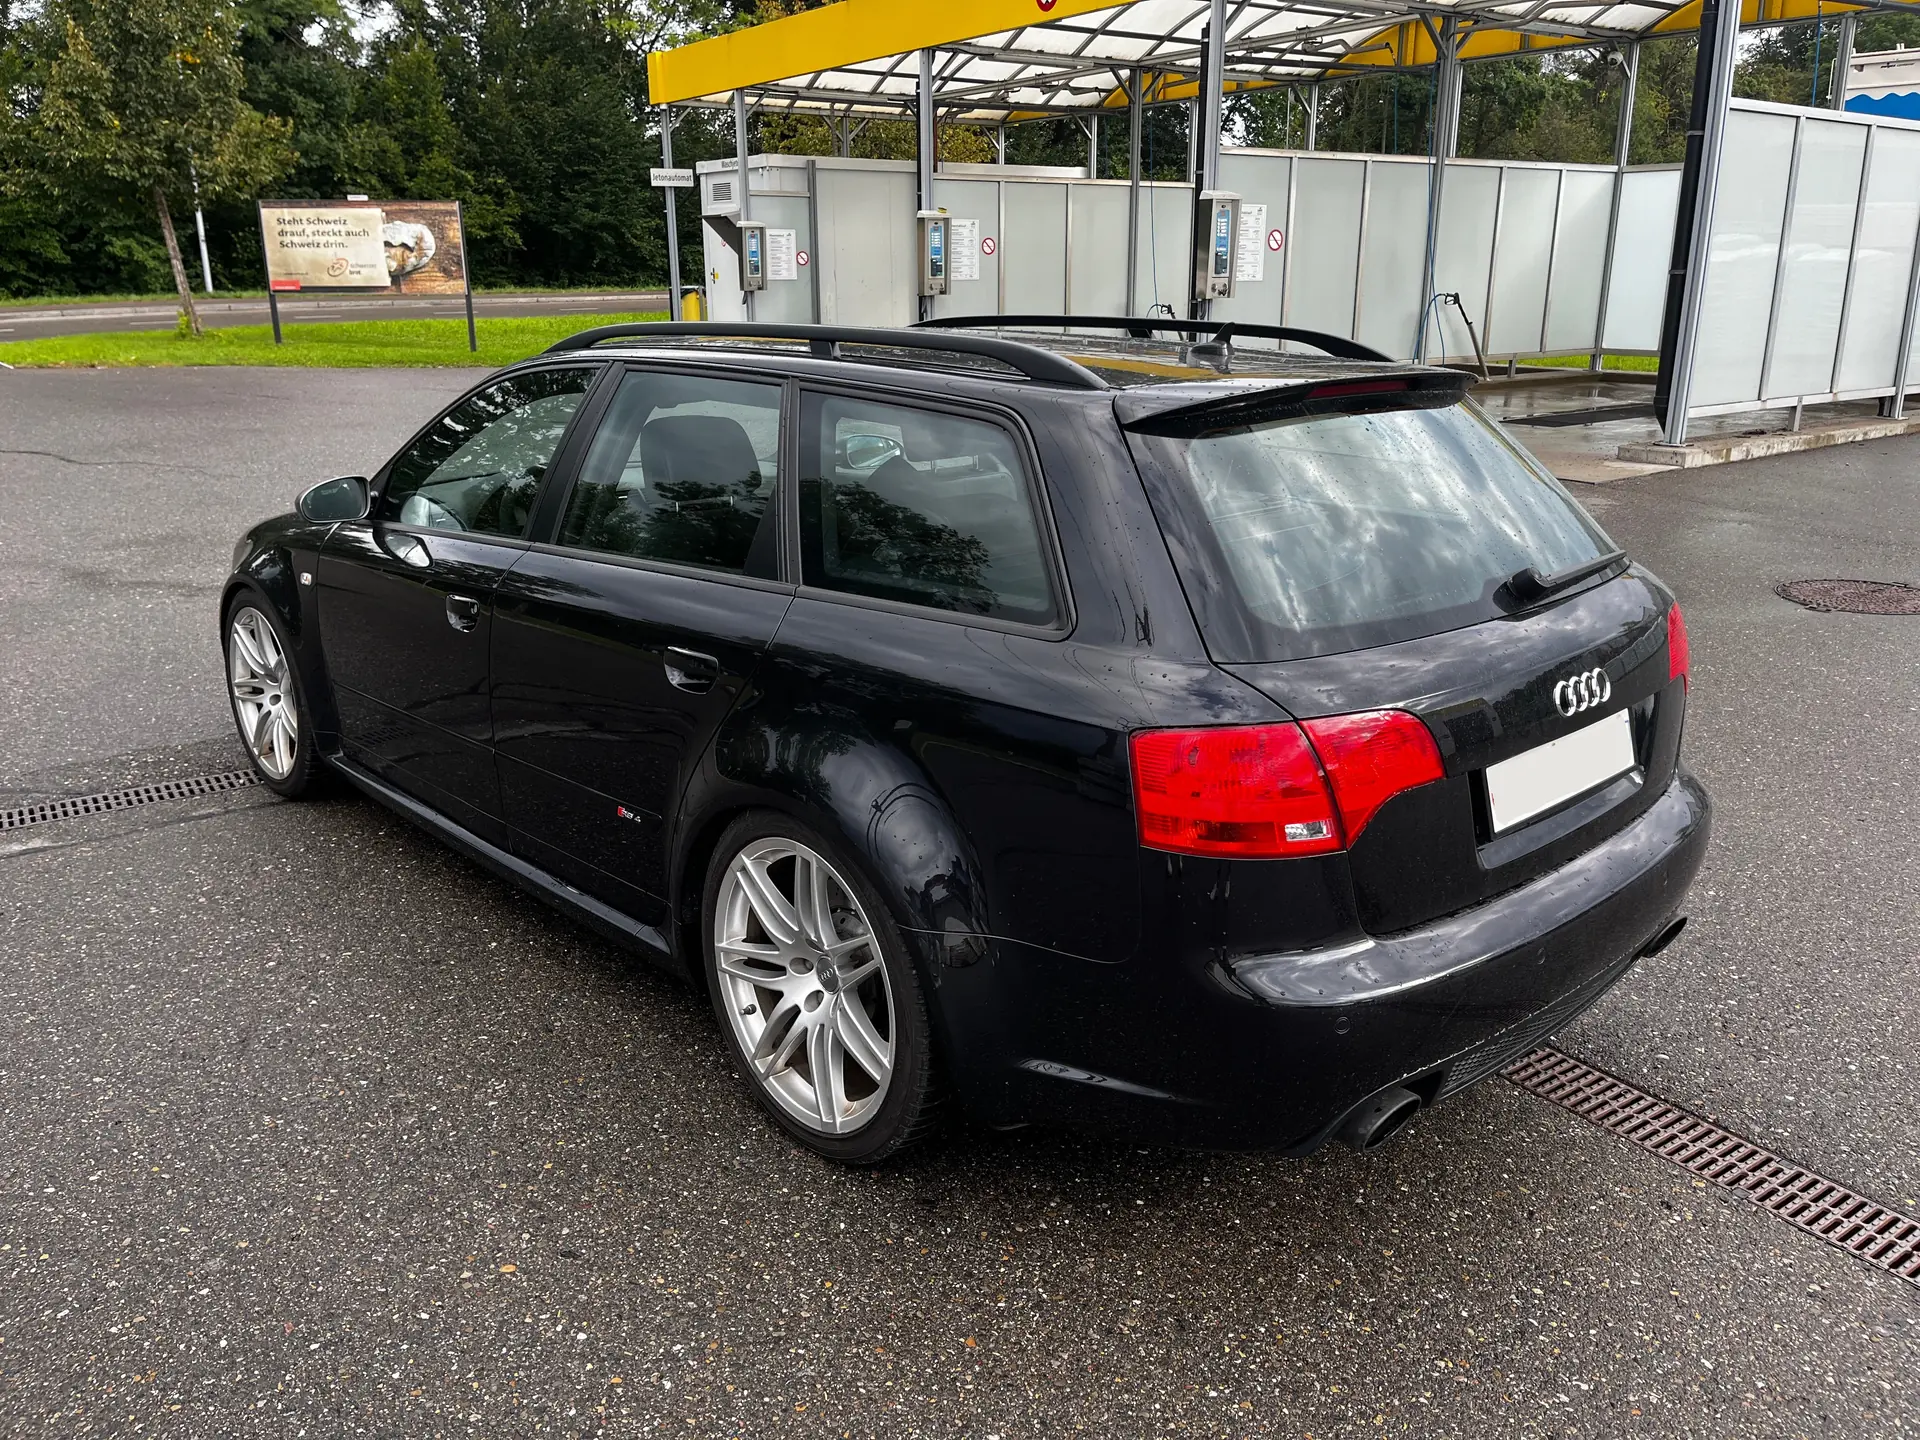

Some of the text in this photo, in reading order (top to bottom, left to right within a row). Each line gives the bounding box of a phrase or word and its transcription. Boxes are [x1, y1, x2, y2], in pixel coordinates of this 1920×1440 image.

[652, 173, 692, 182] Jetonautomat
[276, 216, 348, 226] Steht Schweiz
[277, 228, 370, 238] drauf, steckt auch
[279, 240, 348, 248] Schweiz drin.
